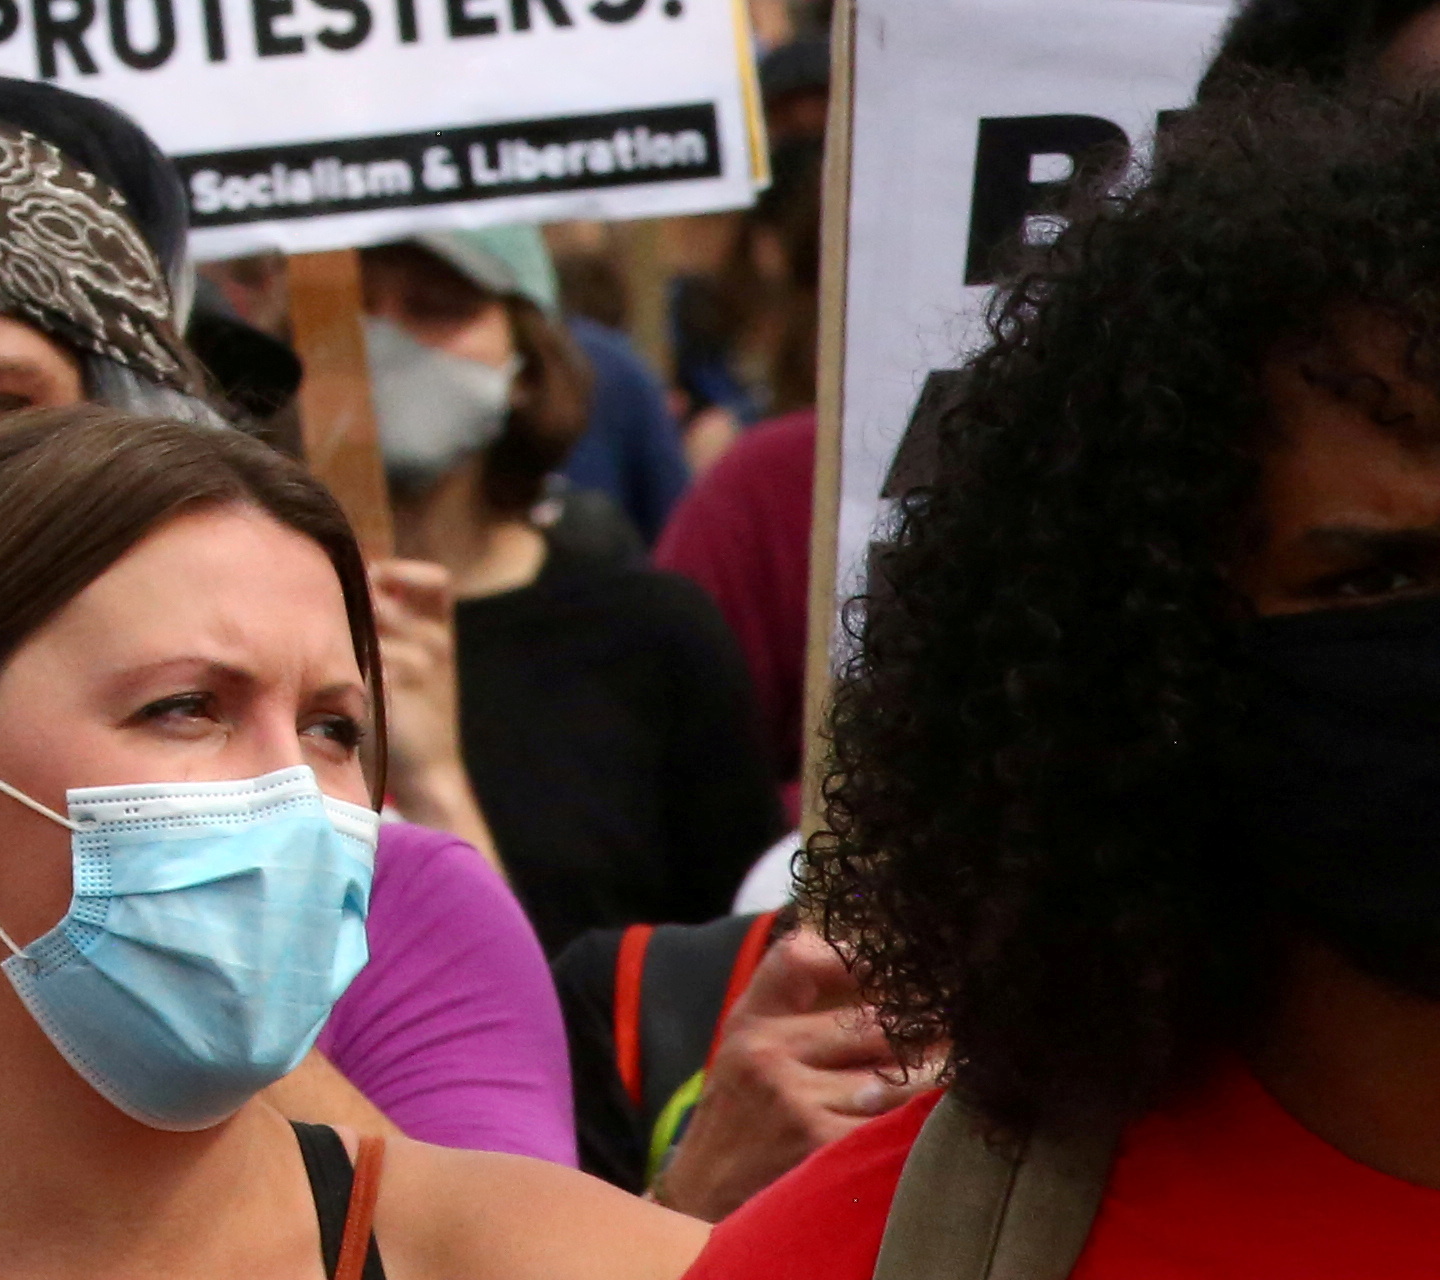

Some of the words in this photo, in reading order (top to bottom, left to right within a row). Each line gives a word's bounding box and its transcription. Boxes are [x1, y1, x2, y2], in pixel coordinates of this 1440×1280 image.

[191, 153, 412, 215] Socialism
[422, 146, 462, 191] &
[473, 124, 707, 185] Liberation
